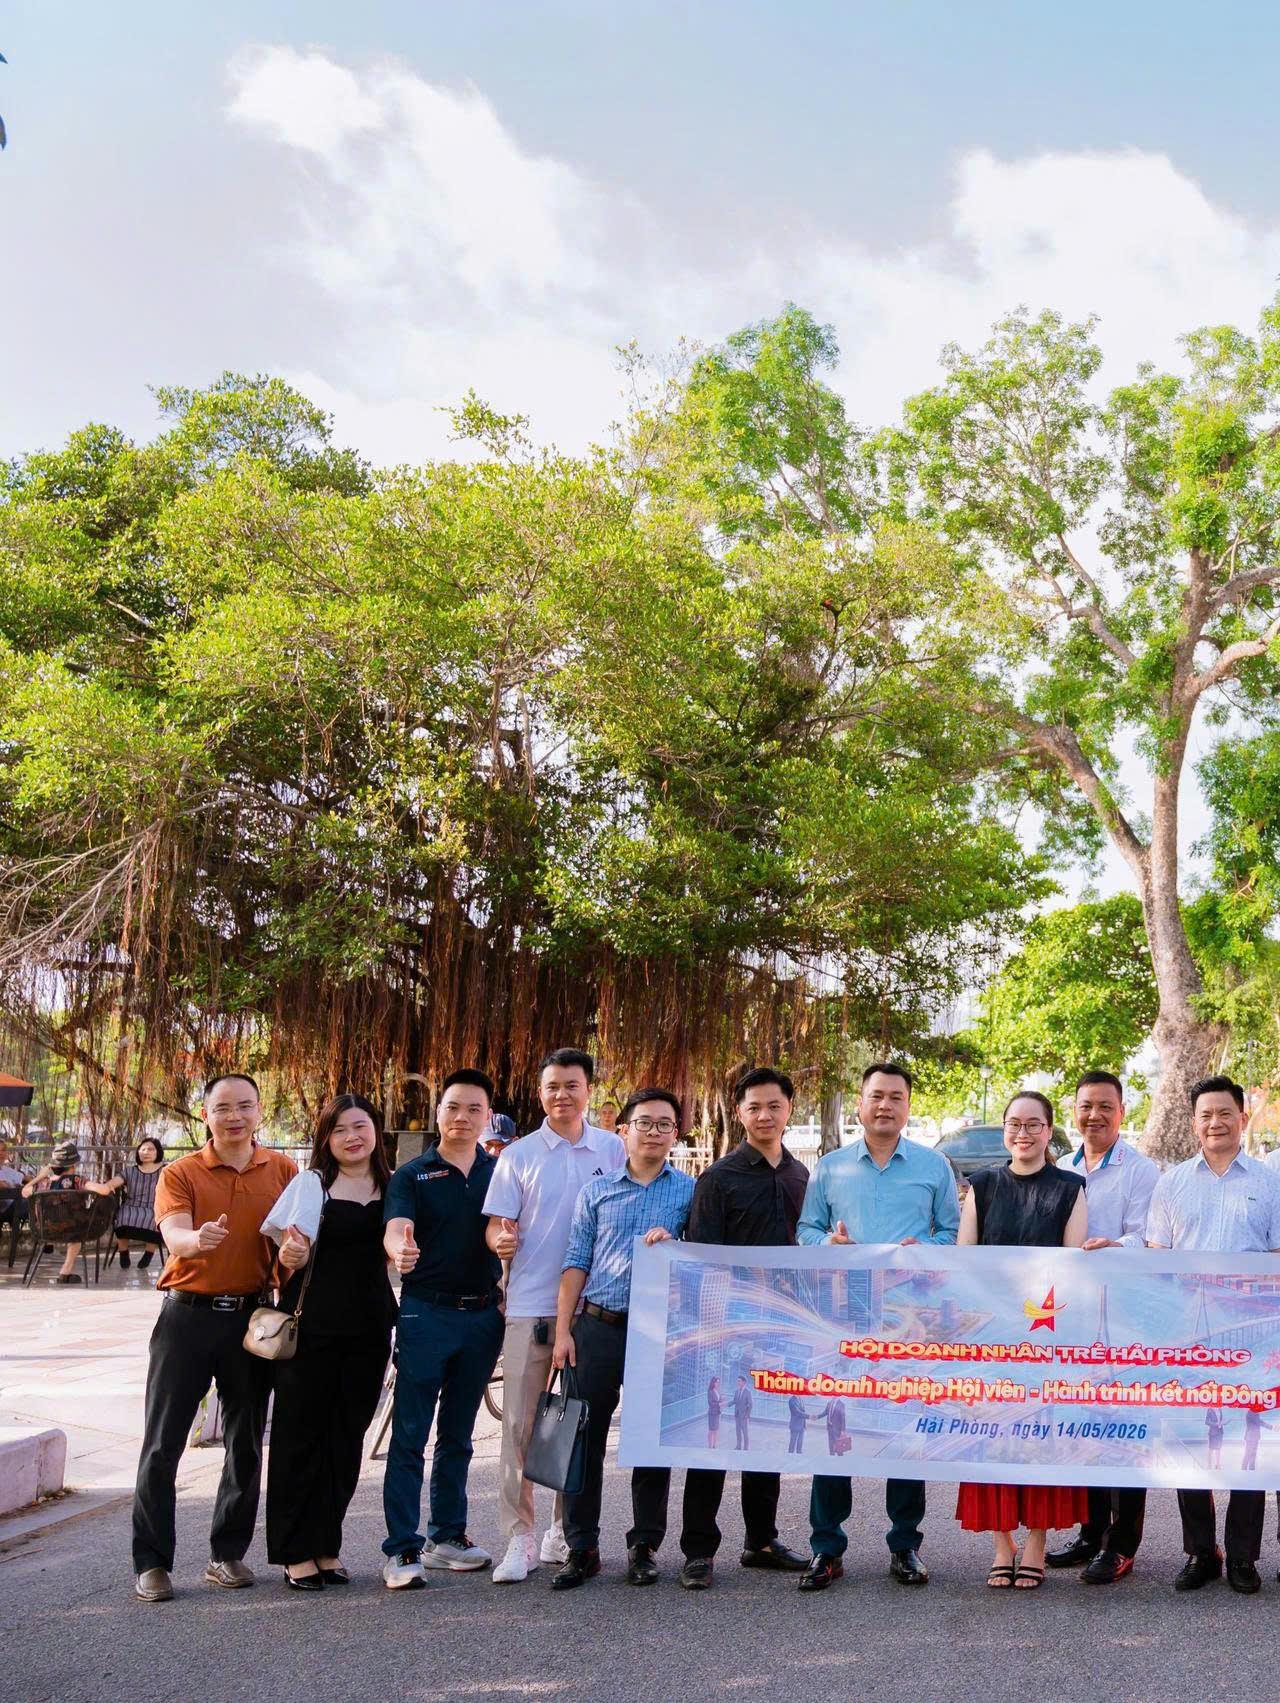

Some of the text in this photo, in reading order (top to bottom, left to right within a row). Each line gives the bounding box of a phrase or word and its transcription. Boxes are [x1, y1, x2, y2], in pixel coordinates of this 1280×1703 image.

[840, 1338, 1252, 1367] HỘI DOANH NHÂN TRẺ HẢI PHÒNG
[750, 1369, 804, 1395] Thăm
[807, 1373, 874, 1398] doanh
[875, 1376, 944, 1405] nghiệp
[946, 1377, 982, 1406] Hội
[984, 1378, 1026, 1403] viên
[1043, 1380, 1096, 1404] Hành
[1099, 1381, 1148, 1405] trình
[1150, 1380, 1185, 1406] kết
[1186, 1381, 1218, 1407] nối
[1219, 1383, 1277, 1412] Đông
[915, 1417, 1148, 1440] Hải Phòng, ngày 14/05/2026
